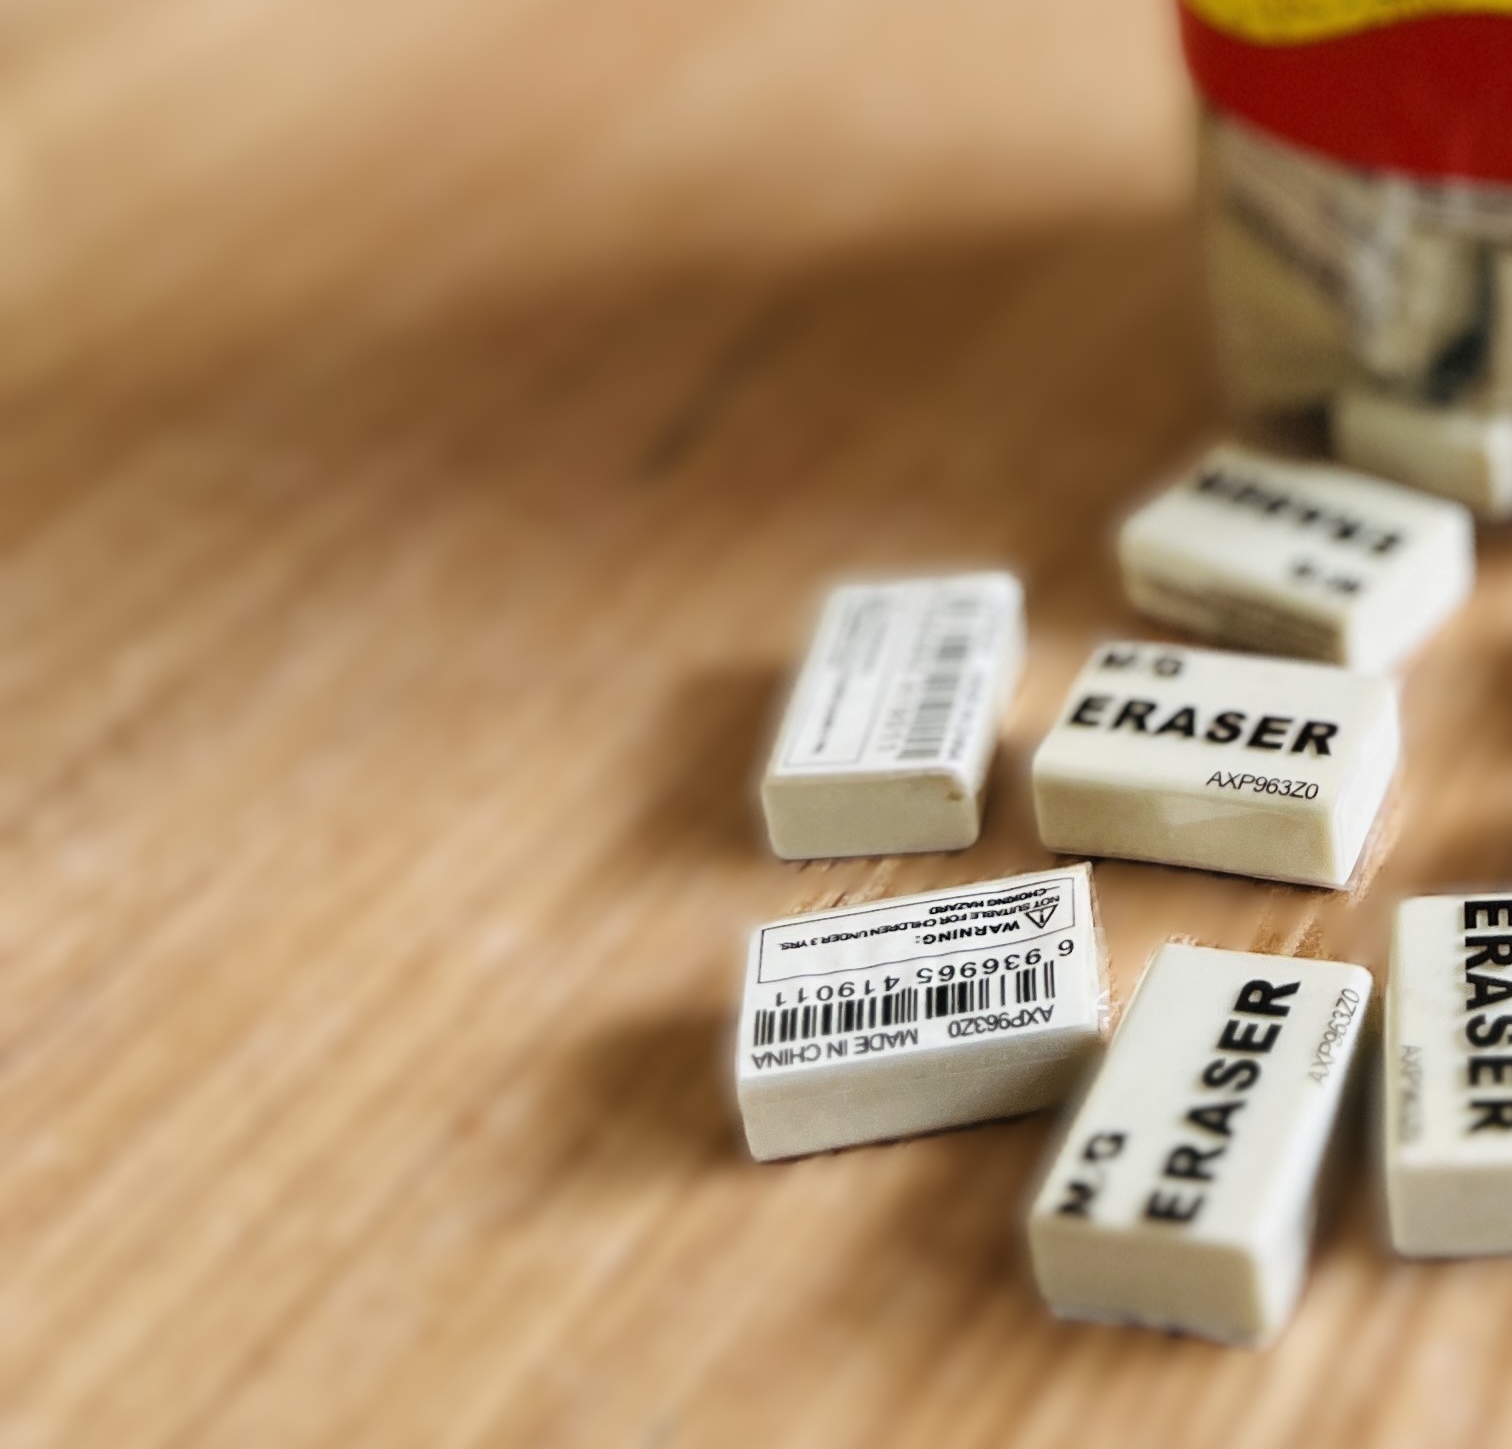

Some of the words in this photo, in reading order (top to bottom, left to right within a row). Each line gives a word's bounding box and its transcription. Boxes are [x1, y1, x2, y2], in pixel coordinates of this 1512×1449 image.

[1068, 694, 1339, 757] ERASER
[1206, 770, 1320, 801] AXP963Z0
[938, 911, 968, 927] FOR
[969, 901, 1031, 922] SUITABLE
[820, 927, 868, 944] UNDER
[914, 919, 1021, 945] WARNING:
[1057, 938, 1076, 957] 6
[916, 948, 1043, 984] 936965
[774, 975, 901, 1007] 419011
[948, 1005, 1055, 1039] AXP963Z0
[827, 1039, 848, 1059] IN
[854, 1027, 919, 1055] MADE
[751, 1043, 822, 1070] CHINA
[1144, 978, 1302, 1223] ERASER
